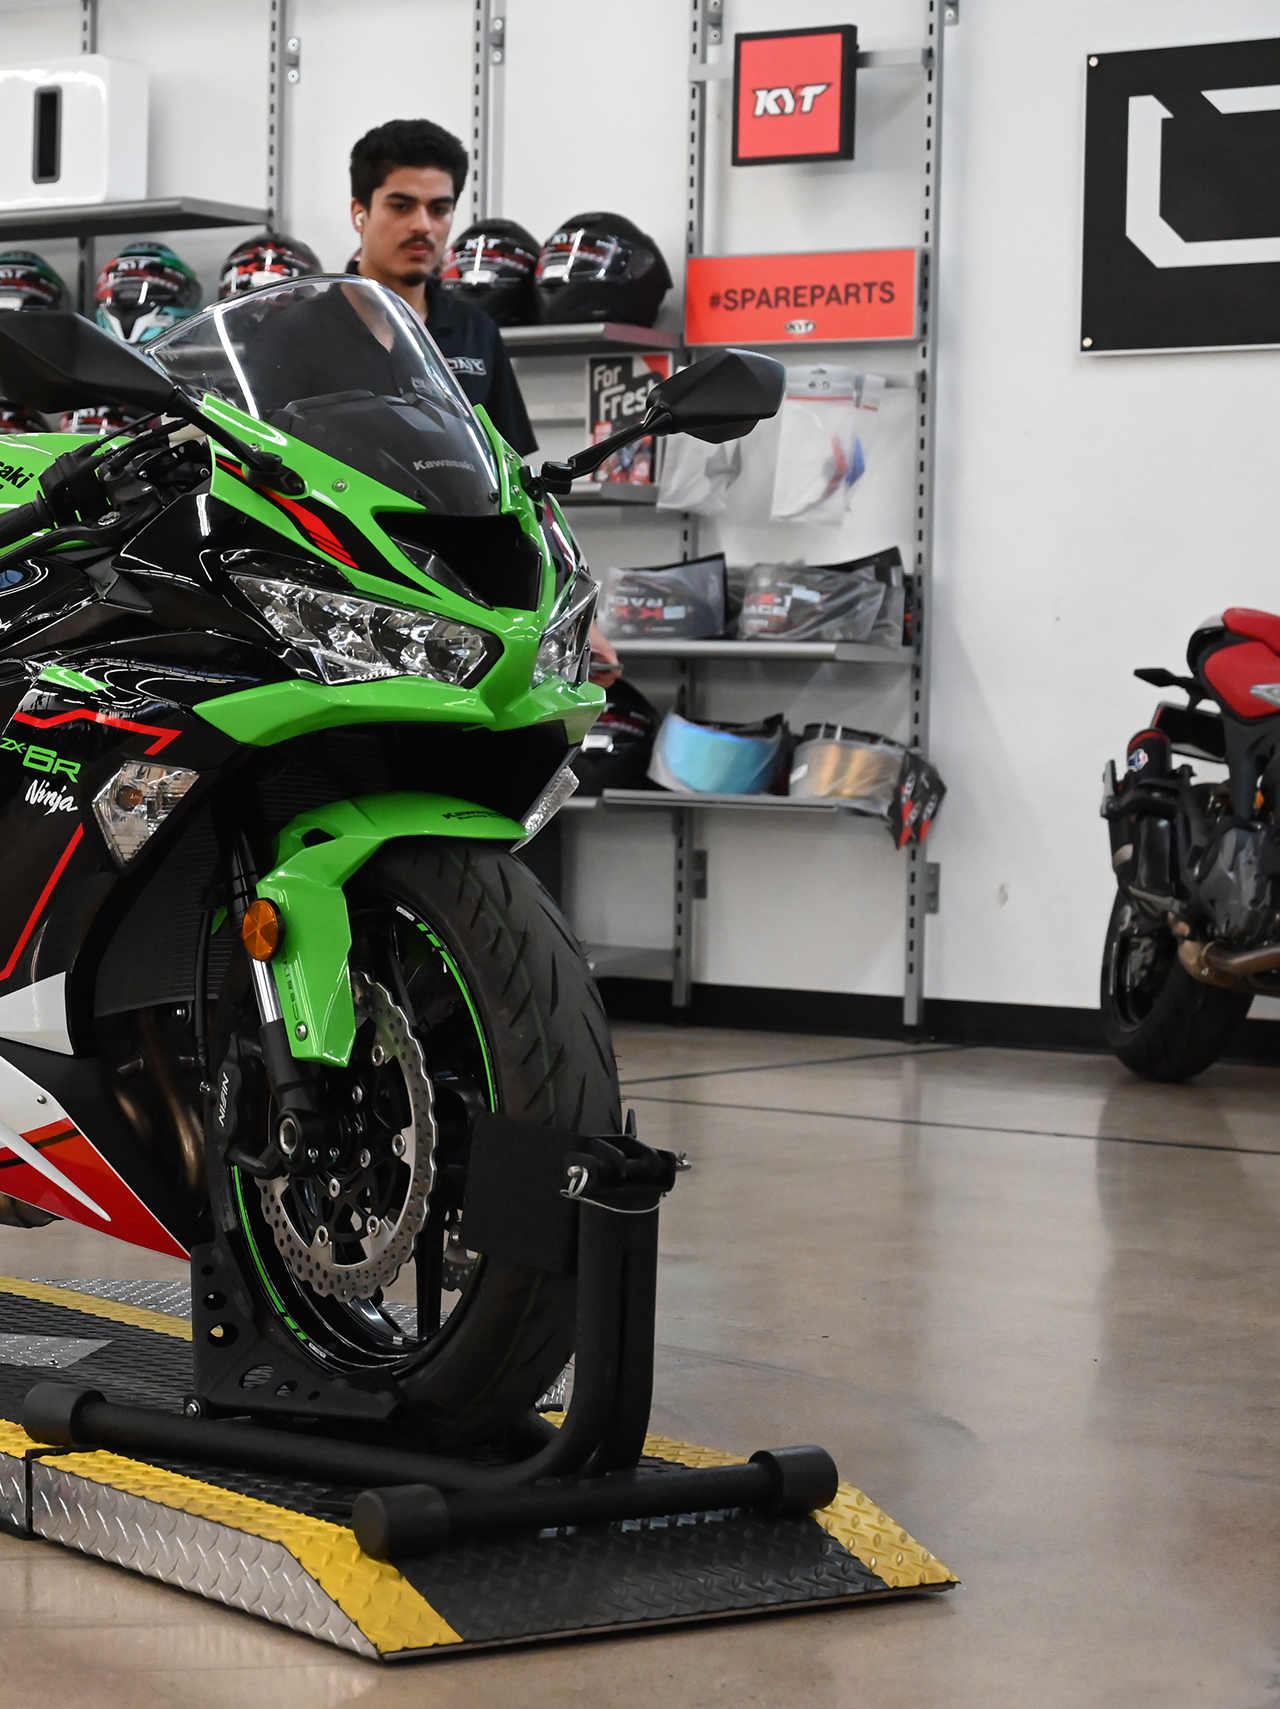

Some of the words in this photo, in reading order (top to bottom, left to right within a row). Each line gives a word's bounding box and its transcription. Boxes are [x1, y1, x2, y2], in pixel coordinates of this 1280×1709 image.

[752, 83, 832, 117] KYT
[709, 280, 896, 312] #SPAREPARTS
[593, 364, 622, 392] For
[600, 379, 659, 421] Fres
[413, 460, 476, 473] Kawasaki
[0, 737, 81, 783] ZX-6R
[24, 779, 78, 816] Ninja
